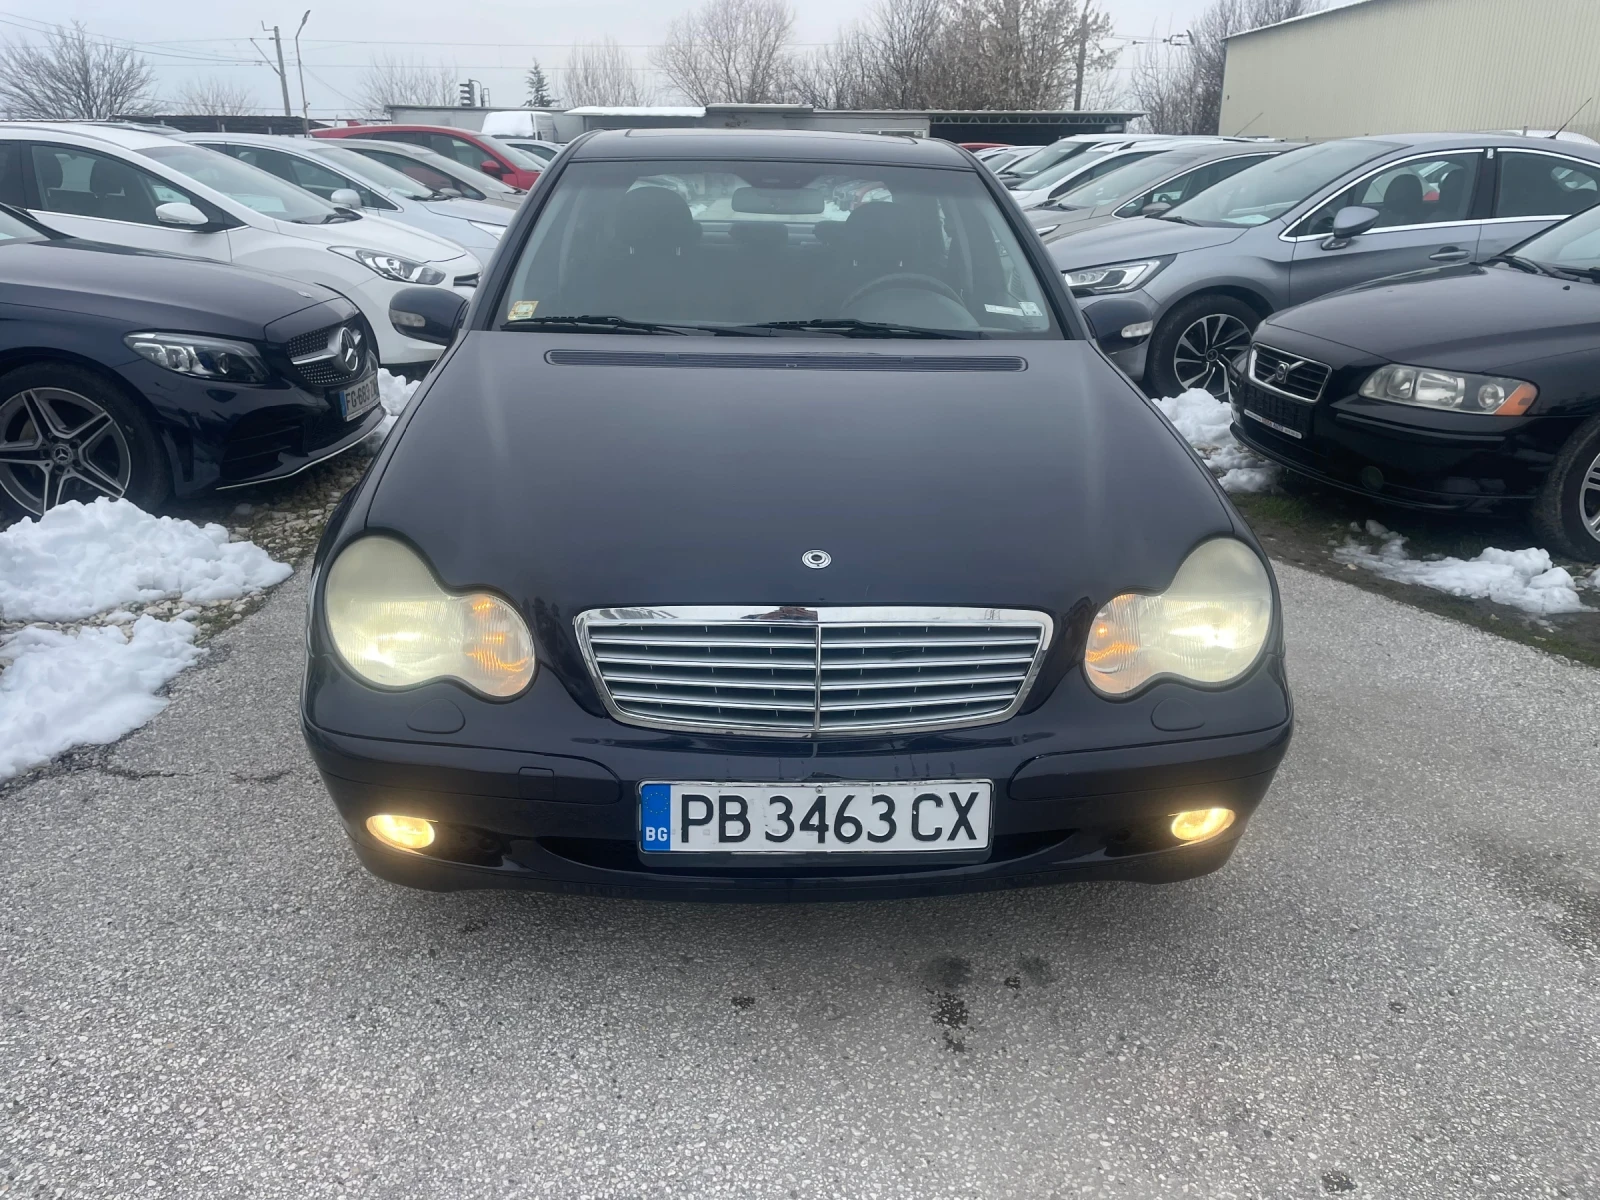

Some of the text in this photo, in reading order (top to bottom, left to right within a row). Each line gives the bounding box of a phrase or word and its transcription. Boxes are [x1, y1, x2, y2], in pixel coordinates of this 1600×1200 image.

[645, 826, 668, 842] BG
[681, 792, 978, 844] PB 3463 CX
